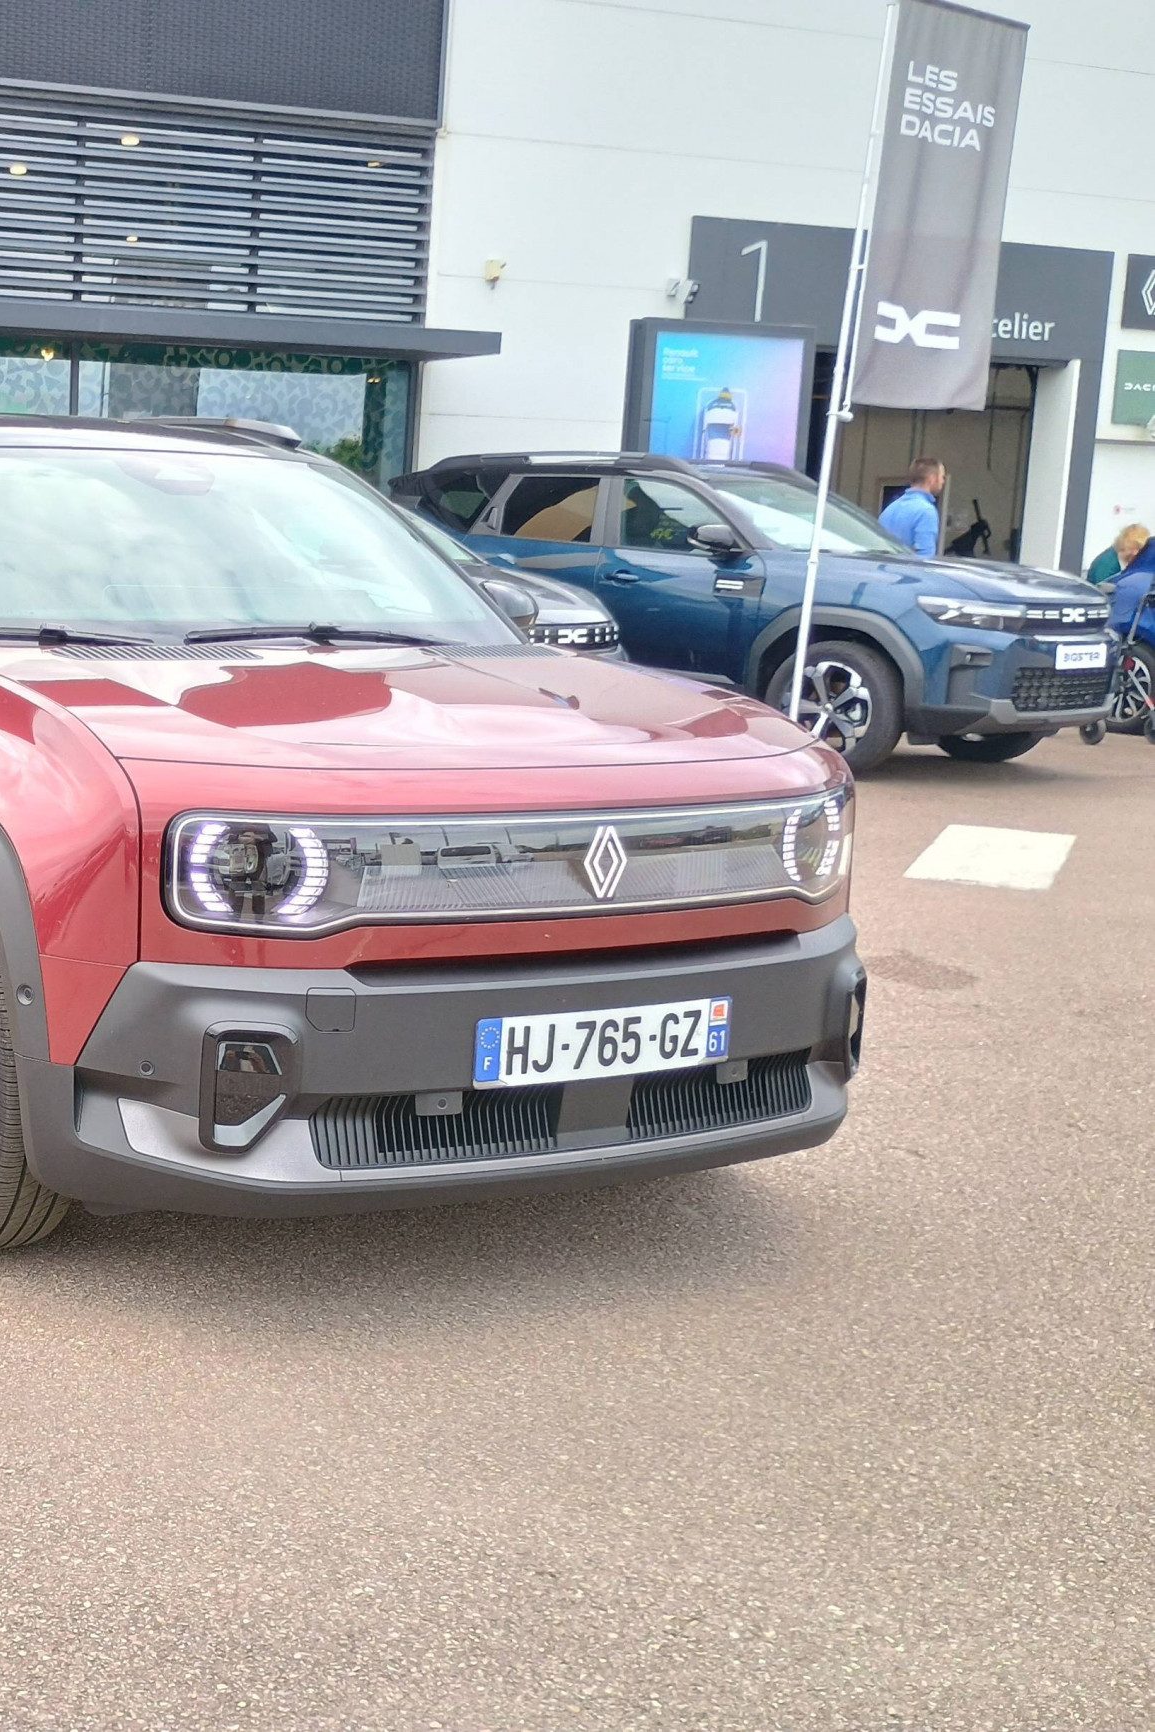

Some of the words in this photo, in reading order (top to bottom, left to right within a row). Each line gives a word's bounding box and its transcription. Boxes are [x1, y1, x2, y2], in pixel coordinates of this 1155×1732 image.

[907, 60, 958, 92] LES
[903, 87, 996, 128] ESSAIS
[899, 113, 981, 152] DACIA
[740, 240, 769, 322] 1
[483, 1056, 493, 1071] F
[505, 1009, 703, 1076] HJ-765-GZ
[708, 1029, 726, 1053] 61
